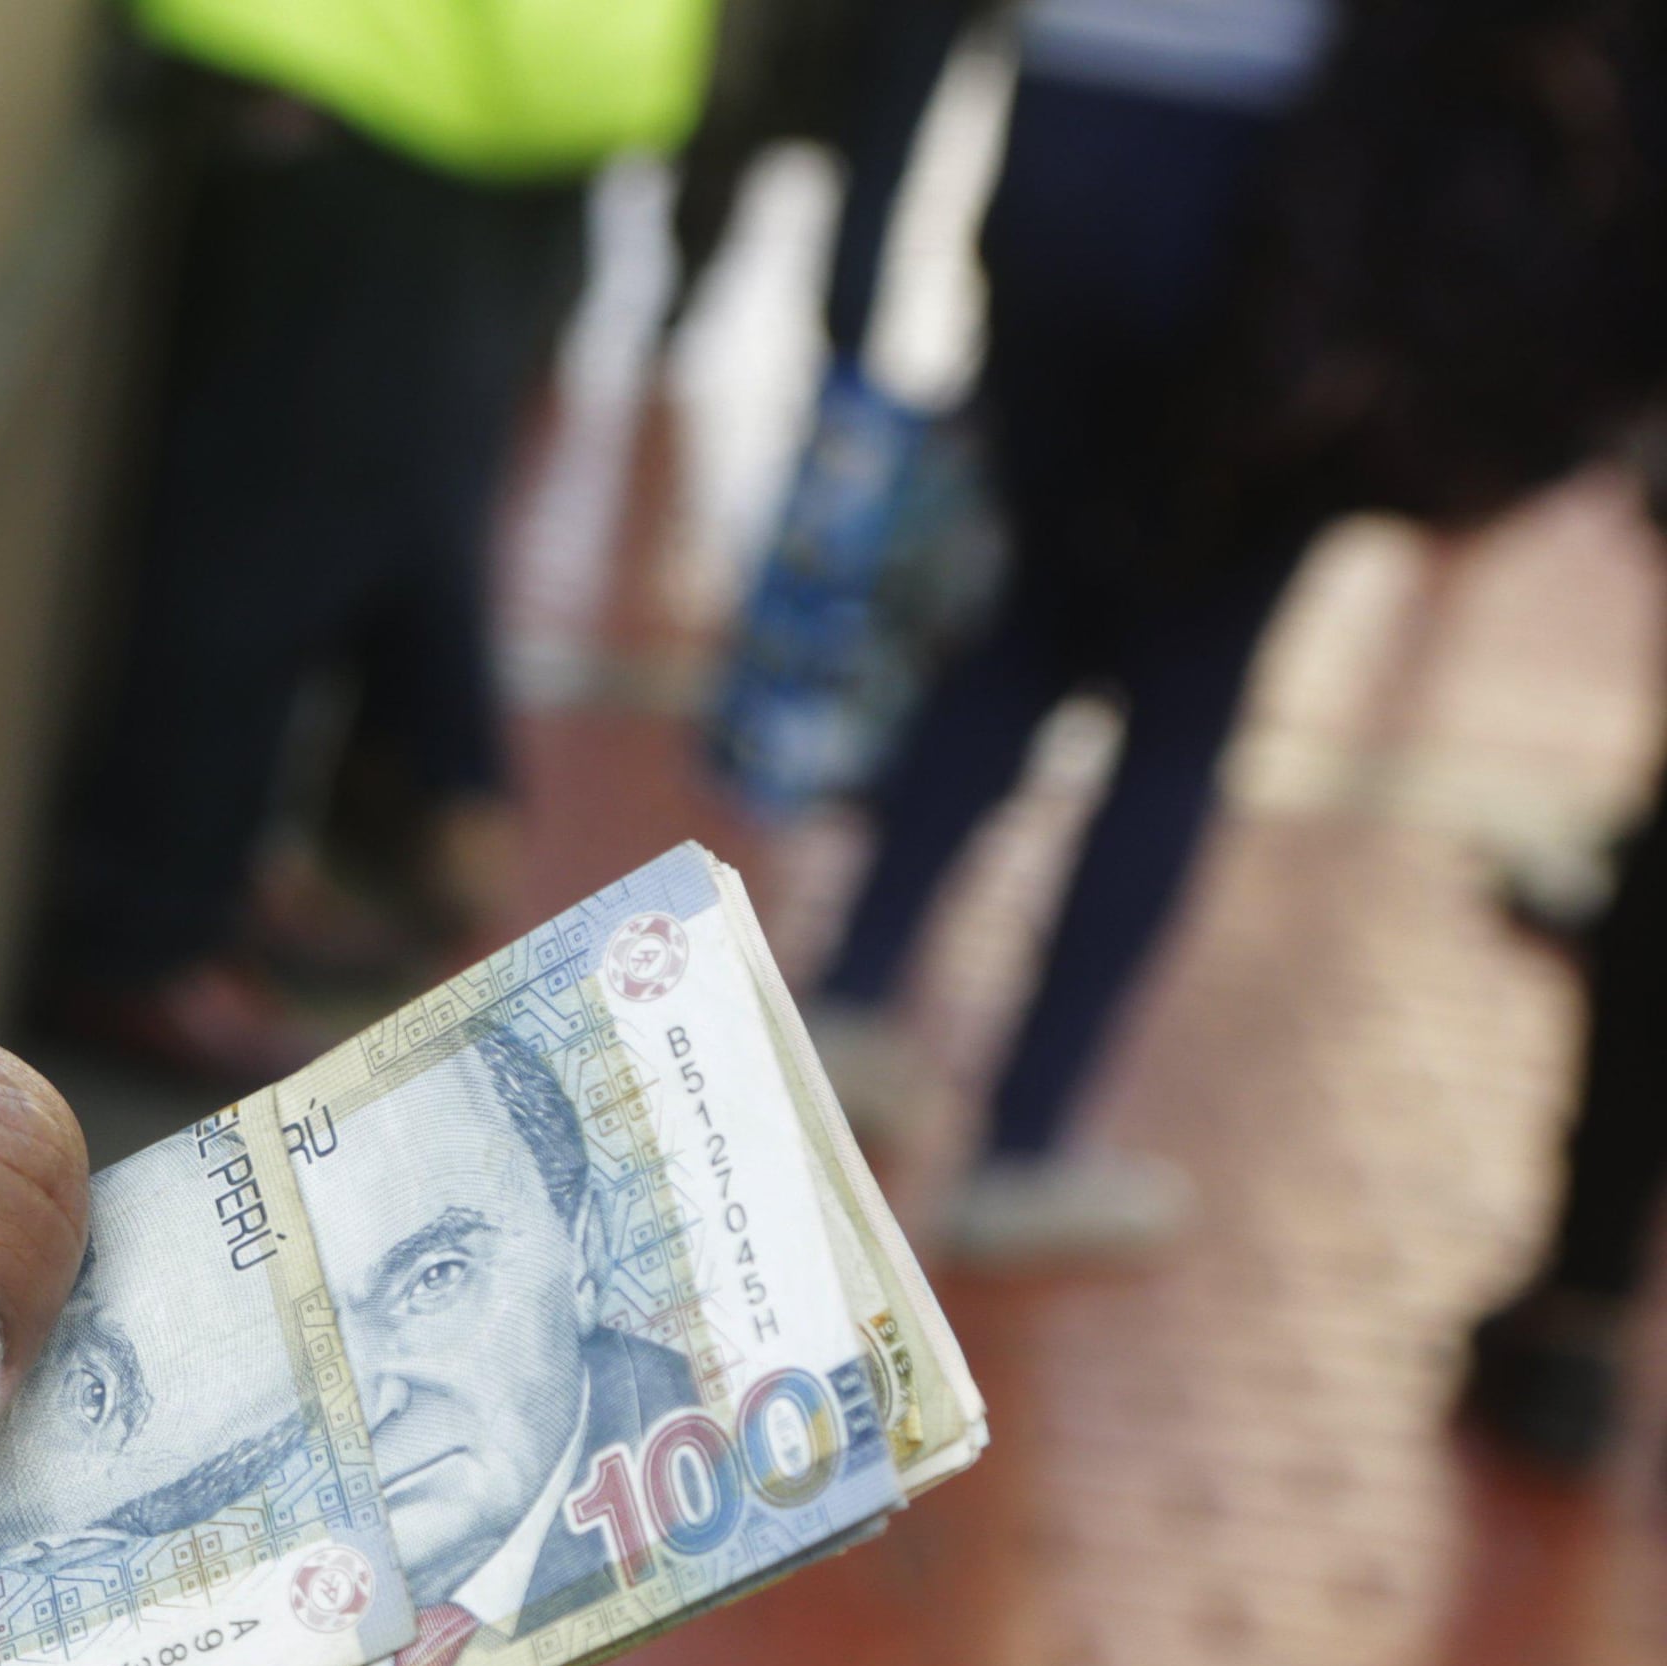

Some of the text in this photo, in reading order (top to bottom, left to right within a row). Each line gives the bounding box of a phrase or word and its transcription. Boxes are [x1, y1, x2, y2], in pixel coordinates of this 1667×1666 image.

[207, 1153, 287, 1271] PERÚ
[667, 1026, 779, 1343] B5127045H
[572, 1367, 841, 1589] 100
